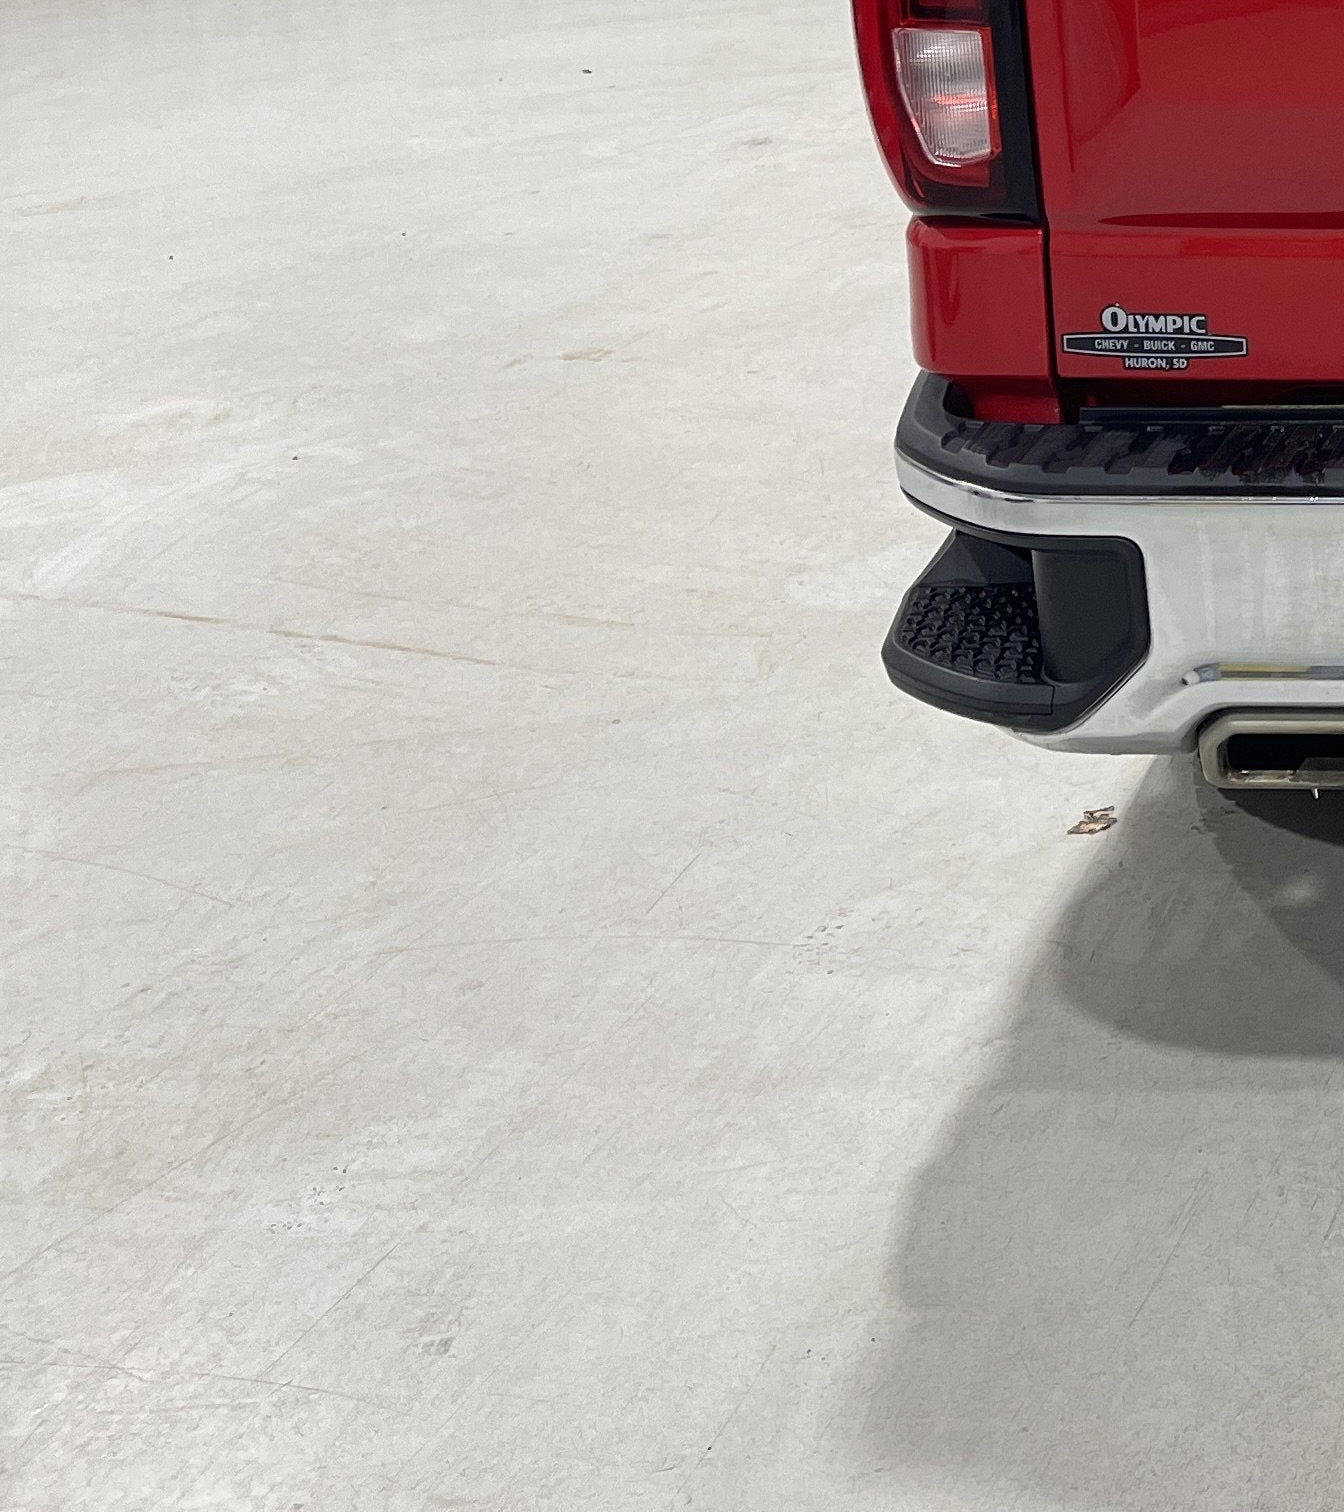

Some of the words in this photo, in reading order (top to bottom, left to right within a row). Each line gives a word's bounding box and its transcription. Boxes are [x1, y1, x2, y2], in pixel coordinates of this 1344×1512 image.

[1094, 339, 1129, 350] CHEVY
[1143, 340, 1176, 351] BUICK
[1190, 340, 1216, 352] GMC
[1125, 357, 1170, 369] HURON,
[1172, 358, 1188, 369] SD
